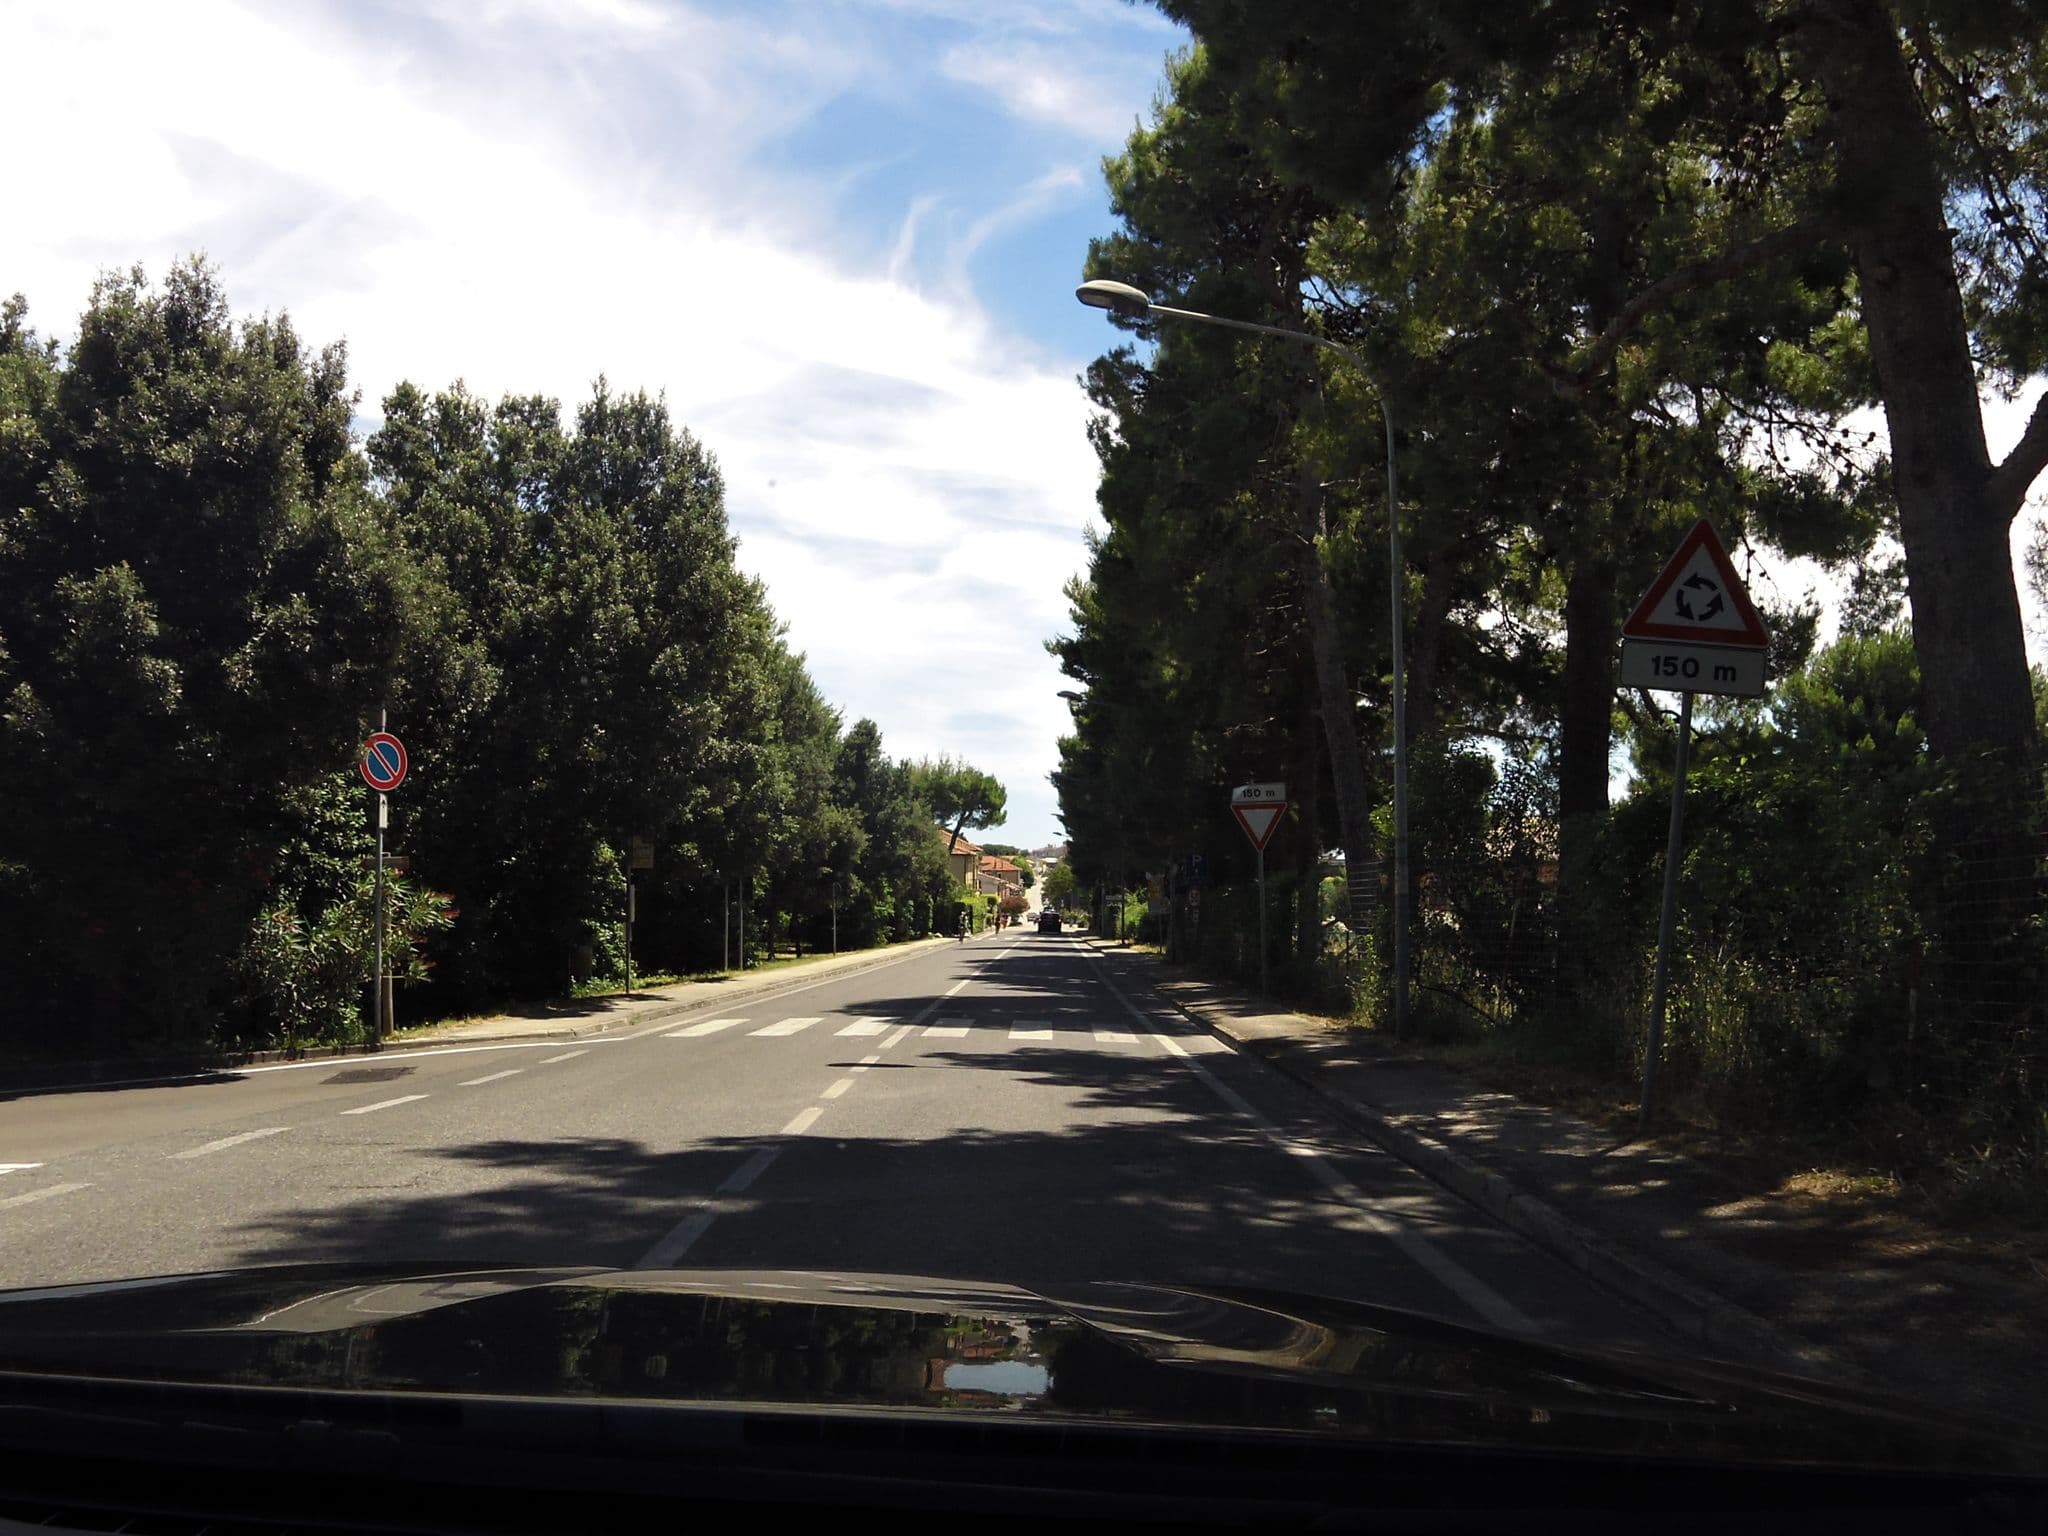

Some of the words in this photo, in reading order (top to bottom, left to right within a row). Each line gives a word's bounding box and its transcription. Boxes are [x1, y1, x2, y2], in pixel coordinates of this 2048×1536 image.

[1652, 655, 1699, 677] 150
[1714, 664, 1736, 681] m
[1242, 788, 1261, 798] 150
